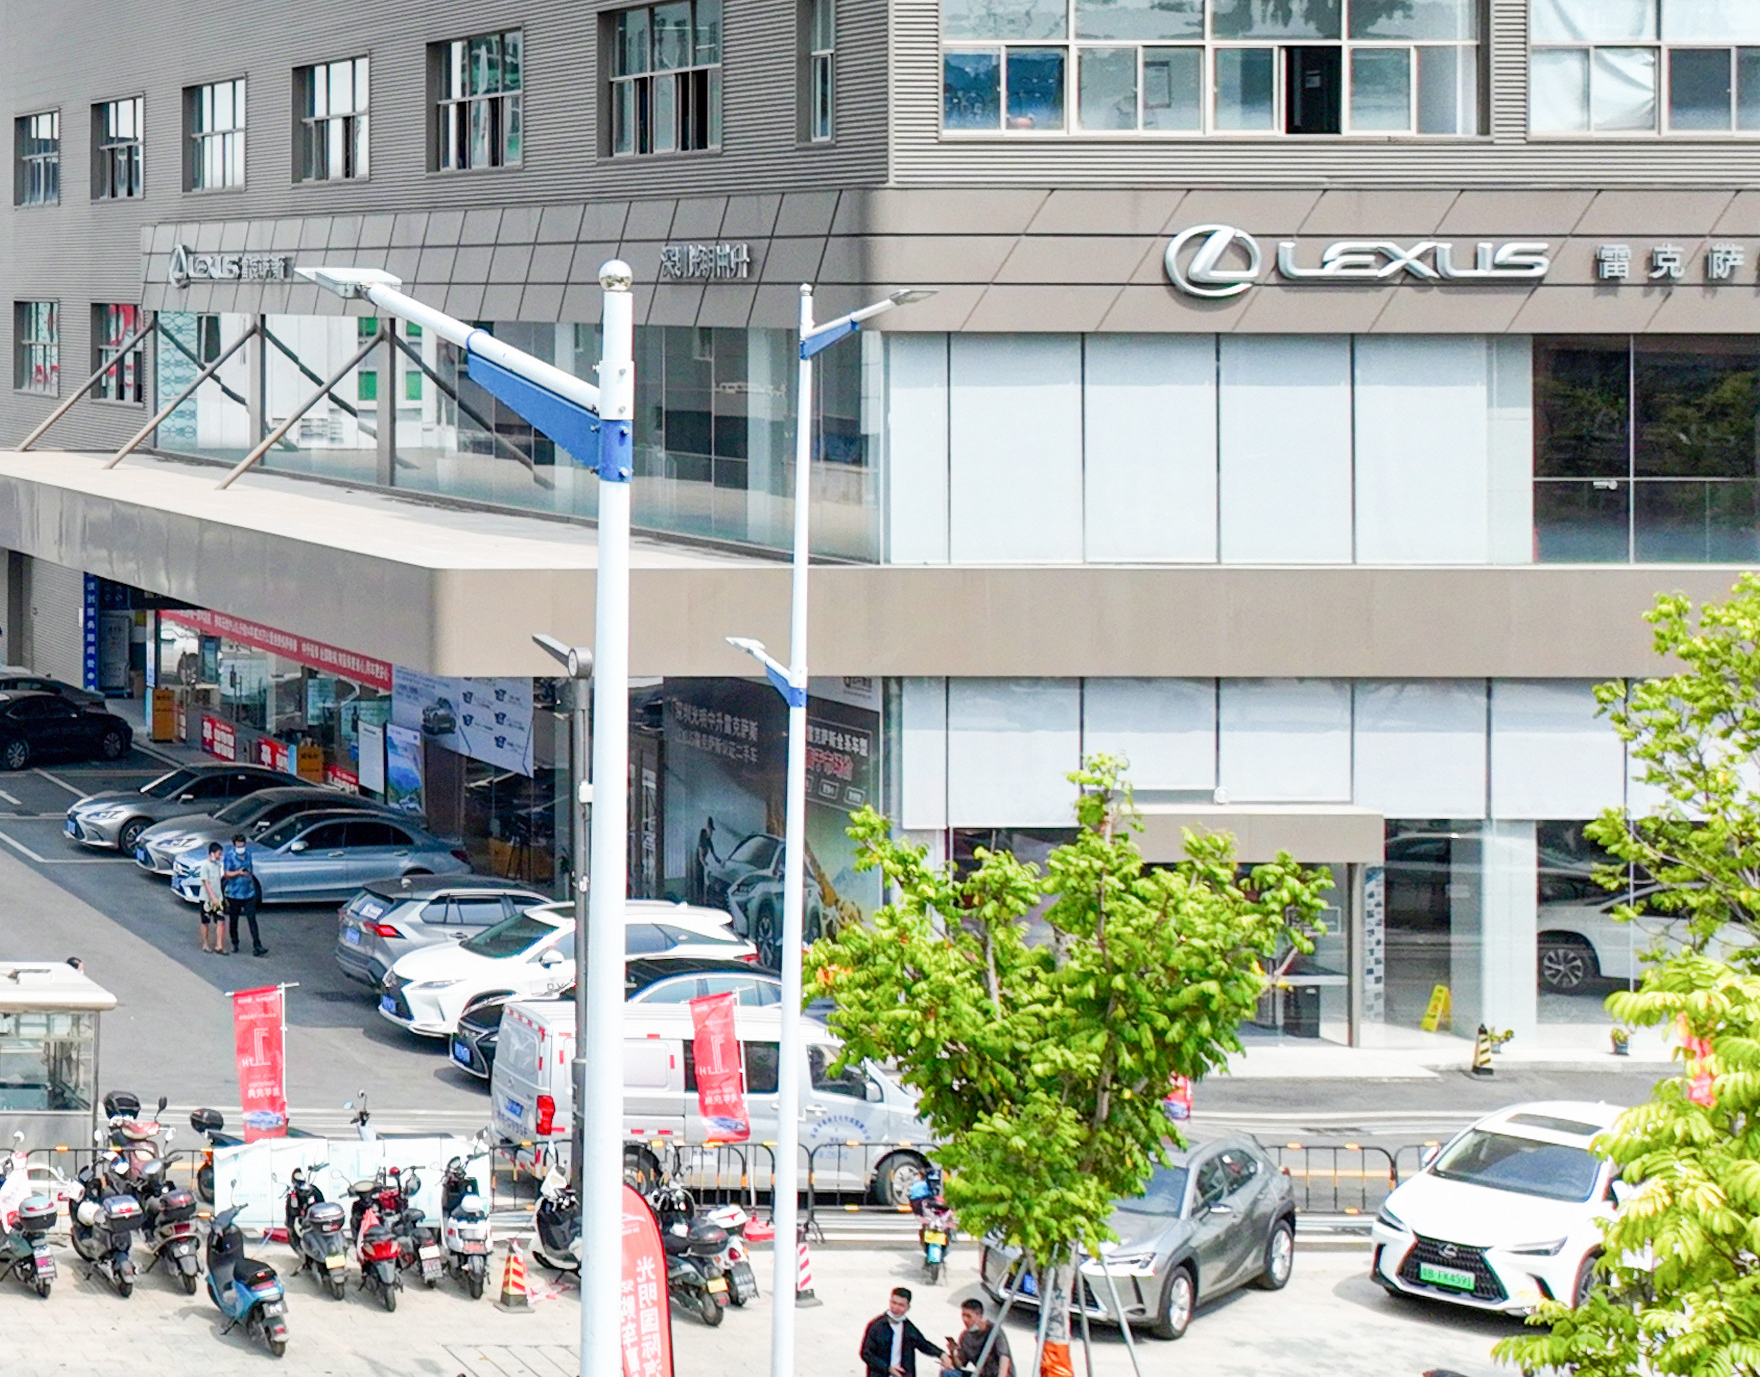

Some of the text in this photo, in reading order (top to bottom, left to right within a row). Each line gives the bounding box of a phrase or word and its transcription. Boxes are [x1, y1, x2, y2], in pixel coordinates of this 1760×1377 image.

[1277, 240, 1550, 280] LEXUS
[1596, 243, 1760, 281] 雷克萨
